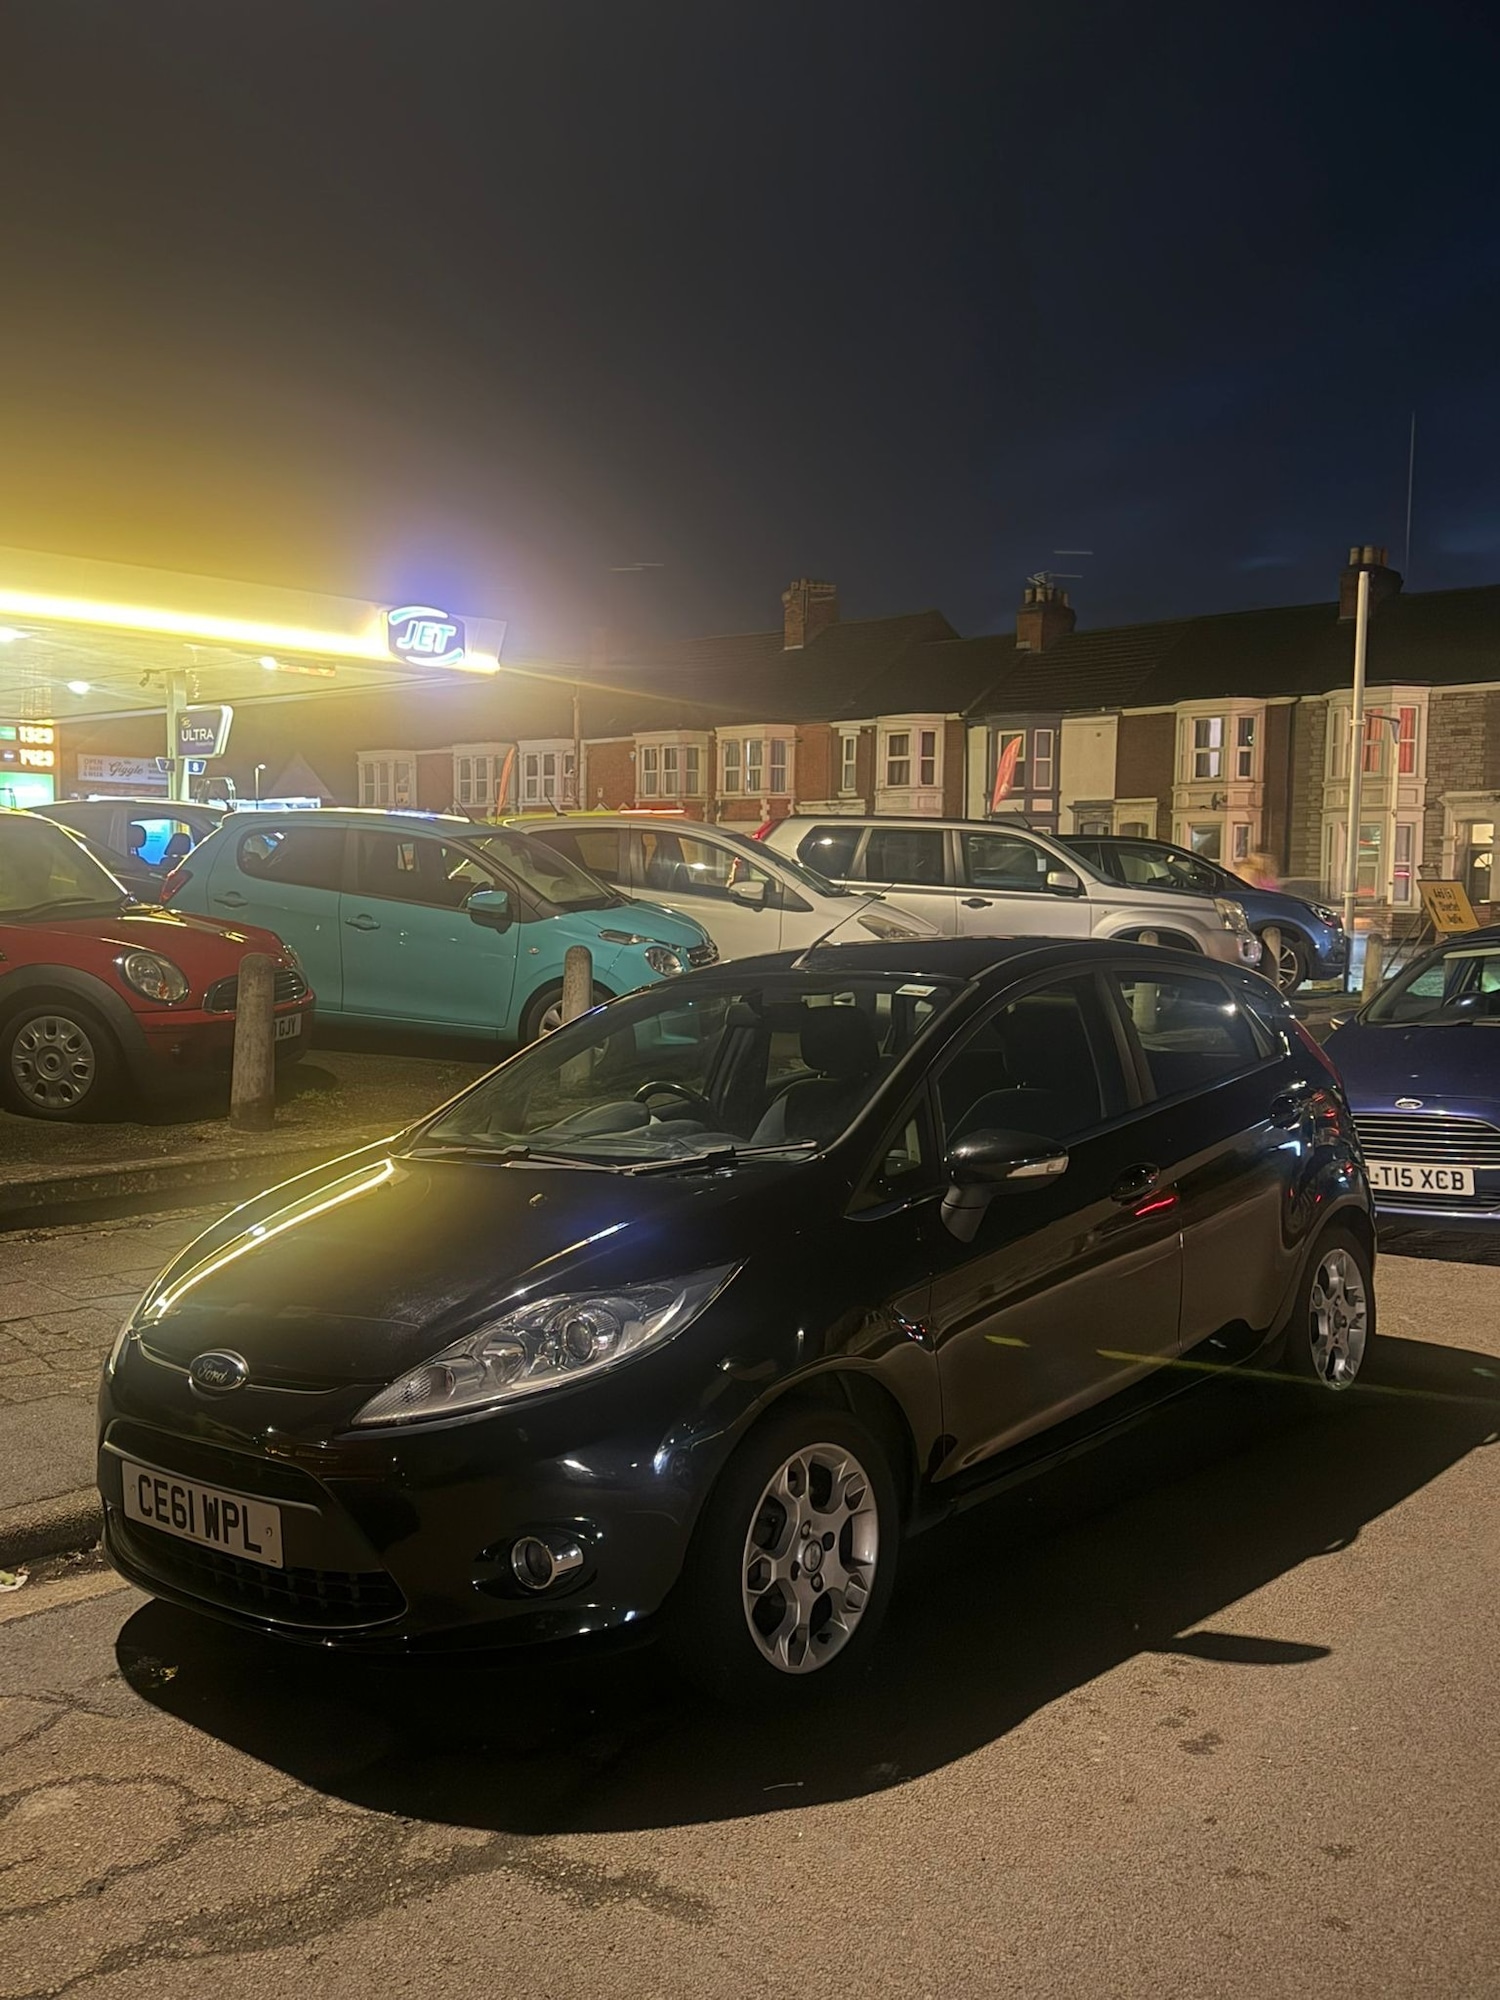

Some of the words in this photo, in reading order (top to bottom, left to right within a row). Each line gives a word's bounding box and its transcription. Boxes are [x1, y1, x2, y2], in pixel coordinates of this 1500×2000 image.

[396, 620, 457, 654] JET
[181, 728, 214, 742] ULTRA
[109, 762, 144, 777] Giggle
[164, 760, 170, 769] 7
[192, 762, 199, 772] 8
[1420, 1168, 1465, 1191] XCB
[197, 1358, 230, 1384] Ford
[138, 1474, 196, 1534] CE61
[202, 1494, 262, 1554] WPL
